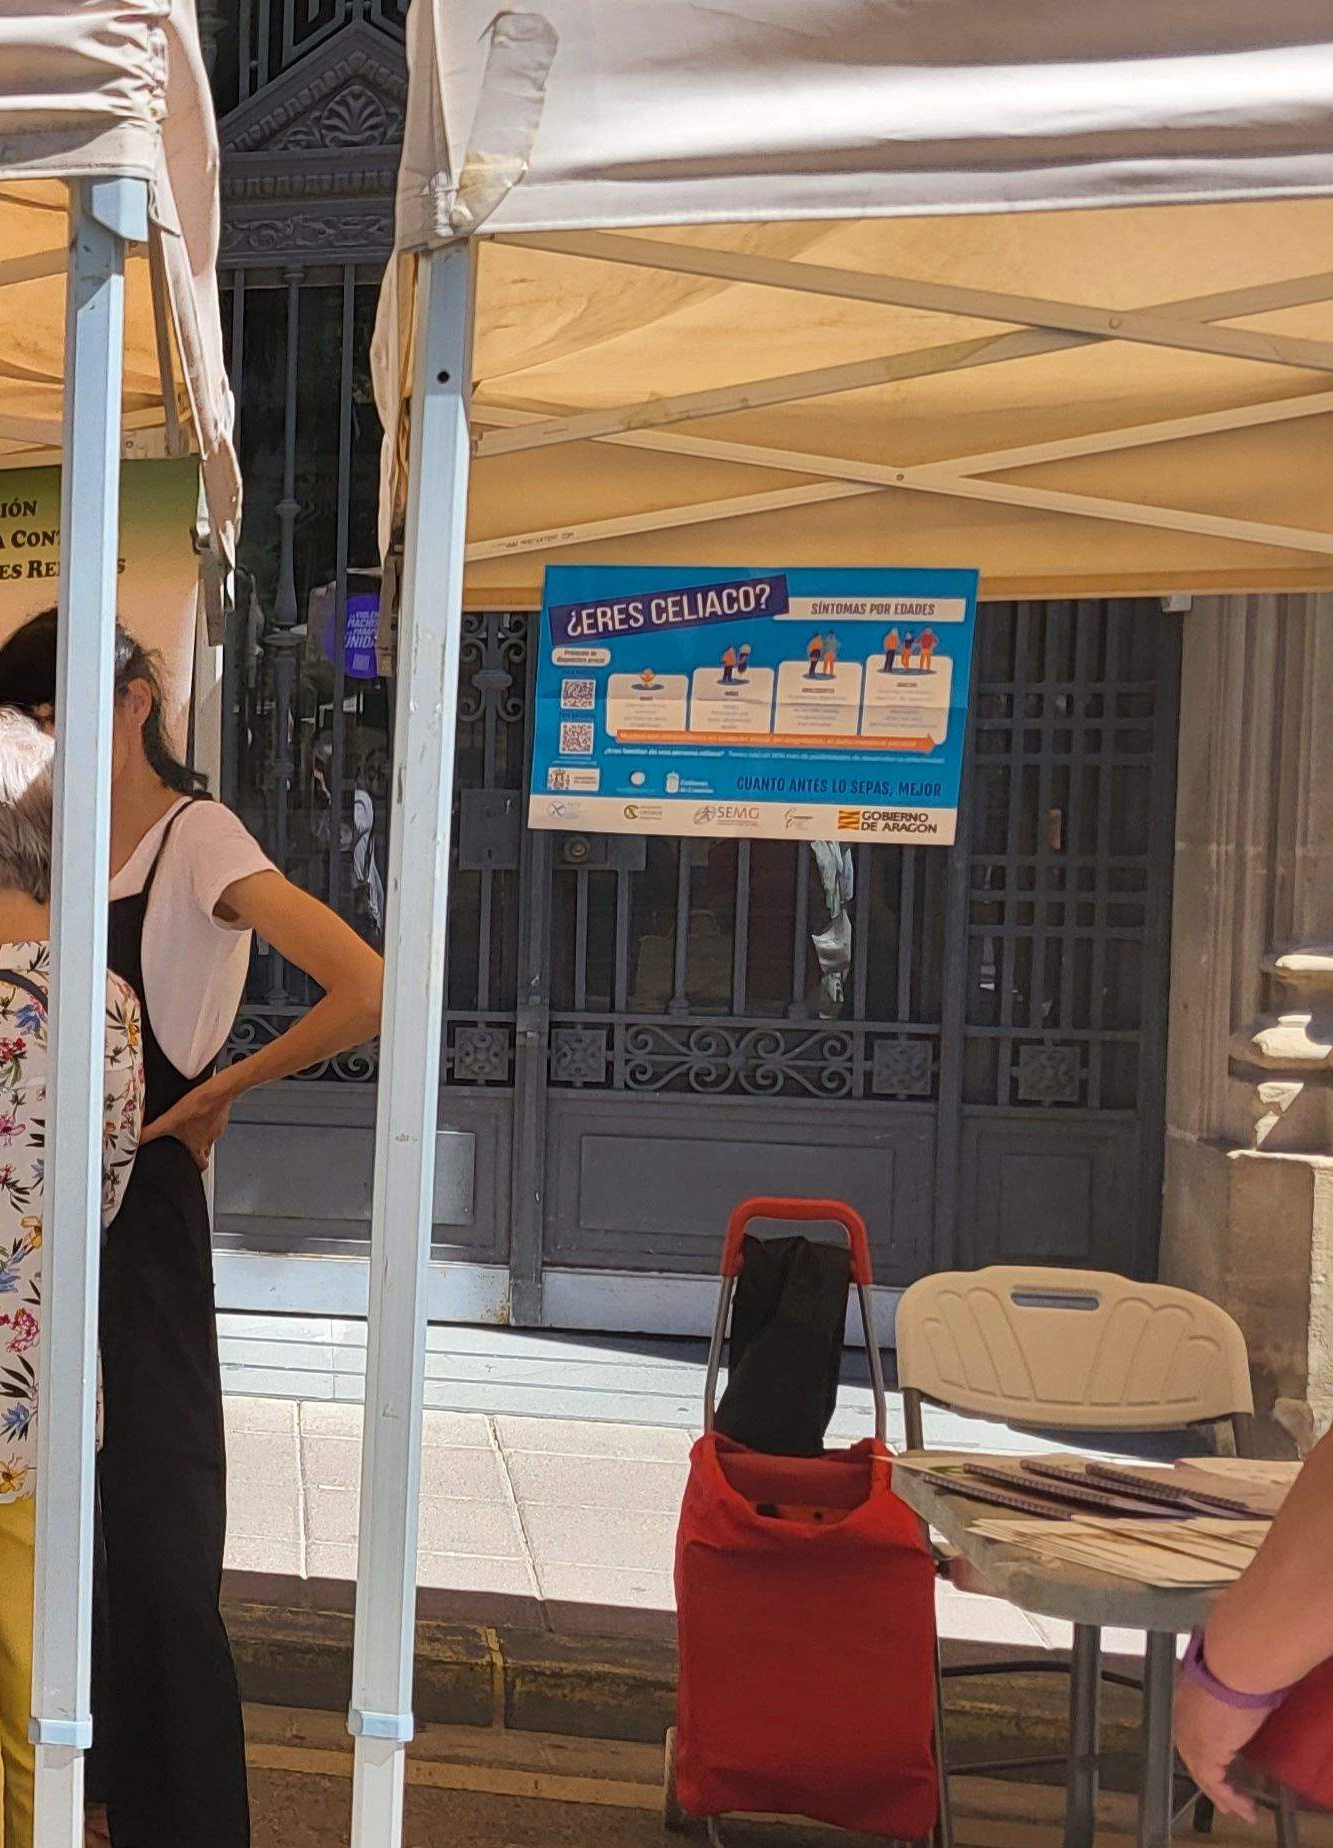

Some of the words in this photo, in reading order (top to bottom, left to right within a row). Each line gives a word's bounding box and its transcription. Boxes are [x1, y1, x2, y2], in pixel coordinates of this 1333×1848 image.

[567, 602, 645, 637] ¿ERES
[650, 584, 771, 625] CELIACO?
[811, 601, 867, 615] SÍNTOMAS
[870, 603, 891, 615] POR
[894, 604, 935, 616] EDADES
[737, 776, 783, 791] CUANTO
[789, 778, 828, 793] ANTES
[833, 780, 847, 793] LO
[851, 780, 893, 796] SEPAS,
[898, 782, 942, 797] MEJOR
[862, 810, 929, 822] GOBIERNO
[861, 821, 878, 832] DE
